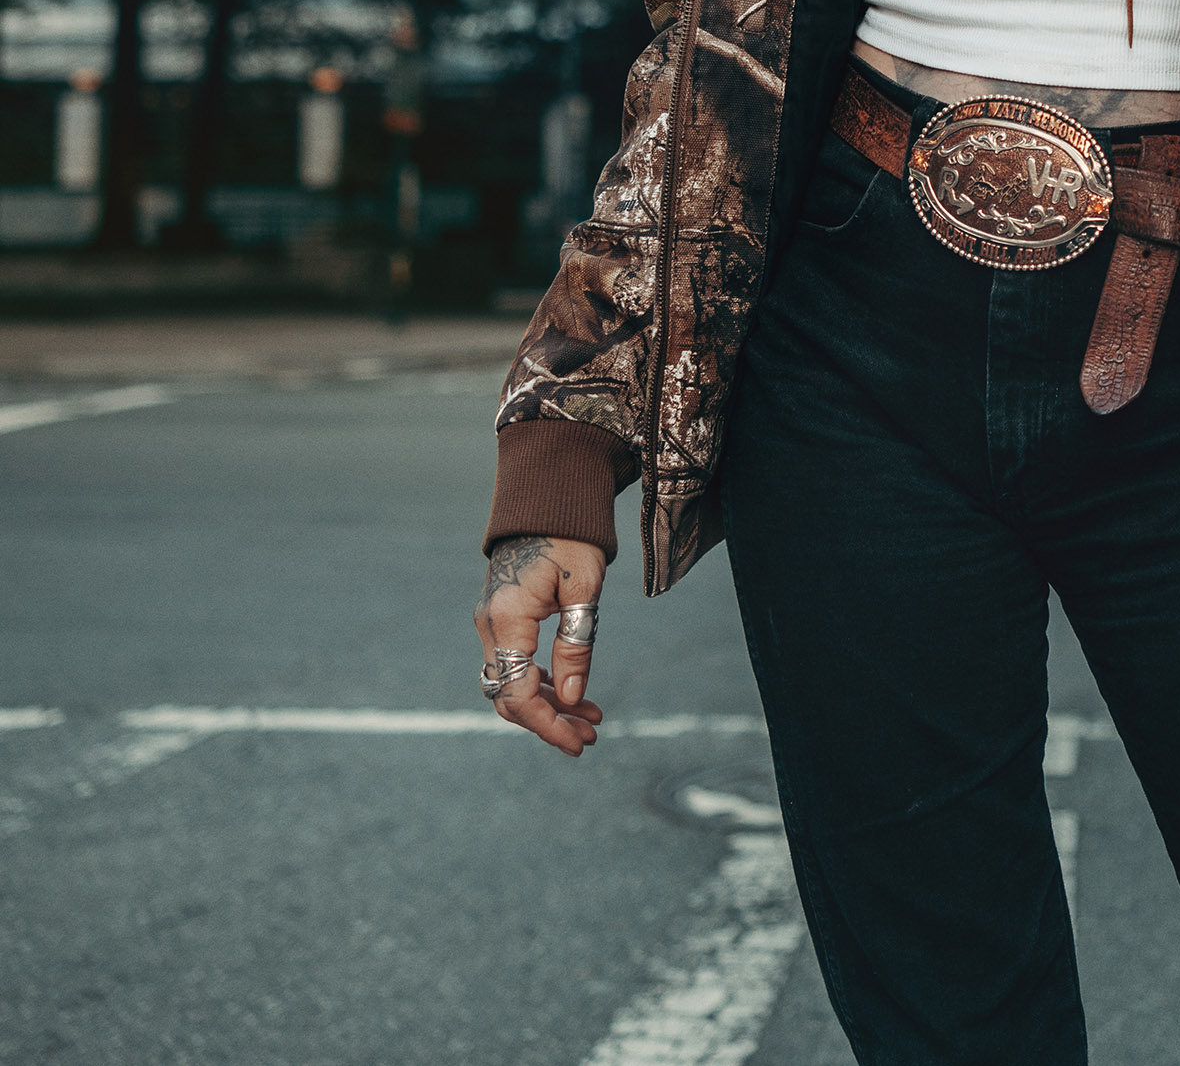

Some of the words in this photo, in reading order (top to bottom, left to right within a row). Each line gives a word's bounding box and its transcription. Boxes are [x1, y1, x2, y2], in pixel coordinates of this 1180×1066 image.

[1028, 108, 1091, 158] MEMORIAL
[980, 240, 1010, 262] HILL
[1014, 245, 1057, 264] ARENA
